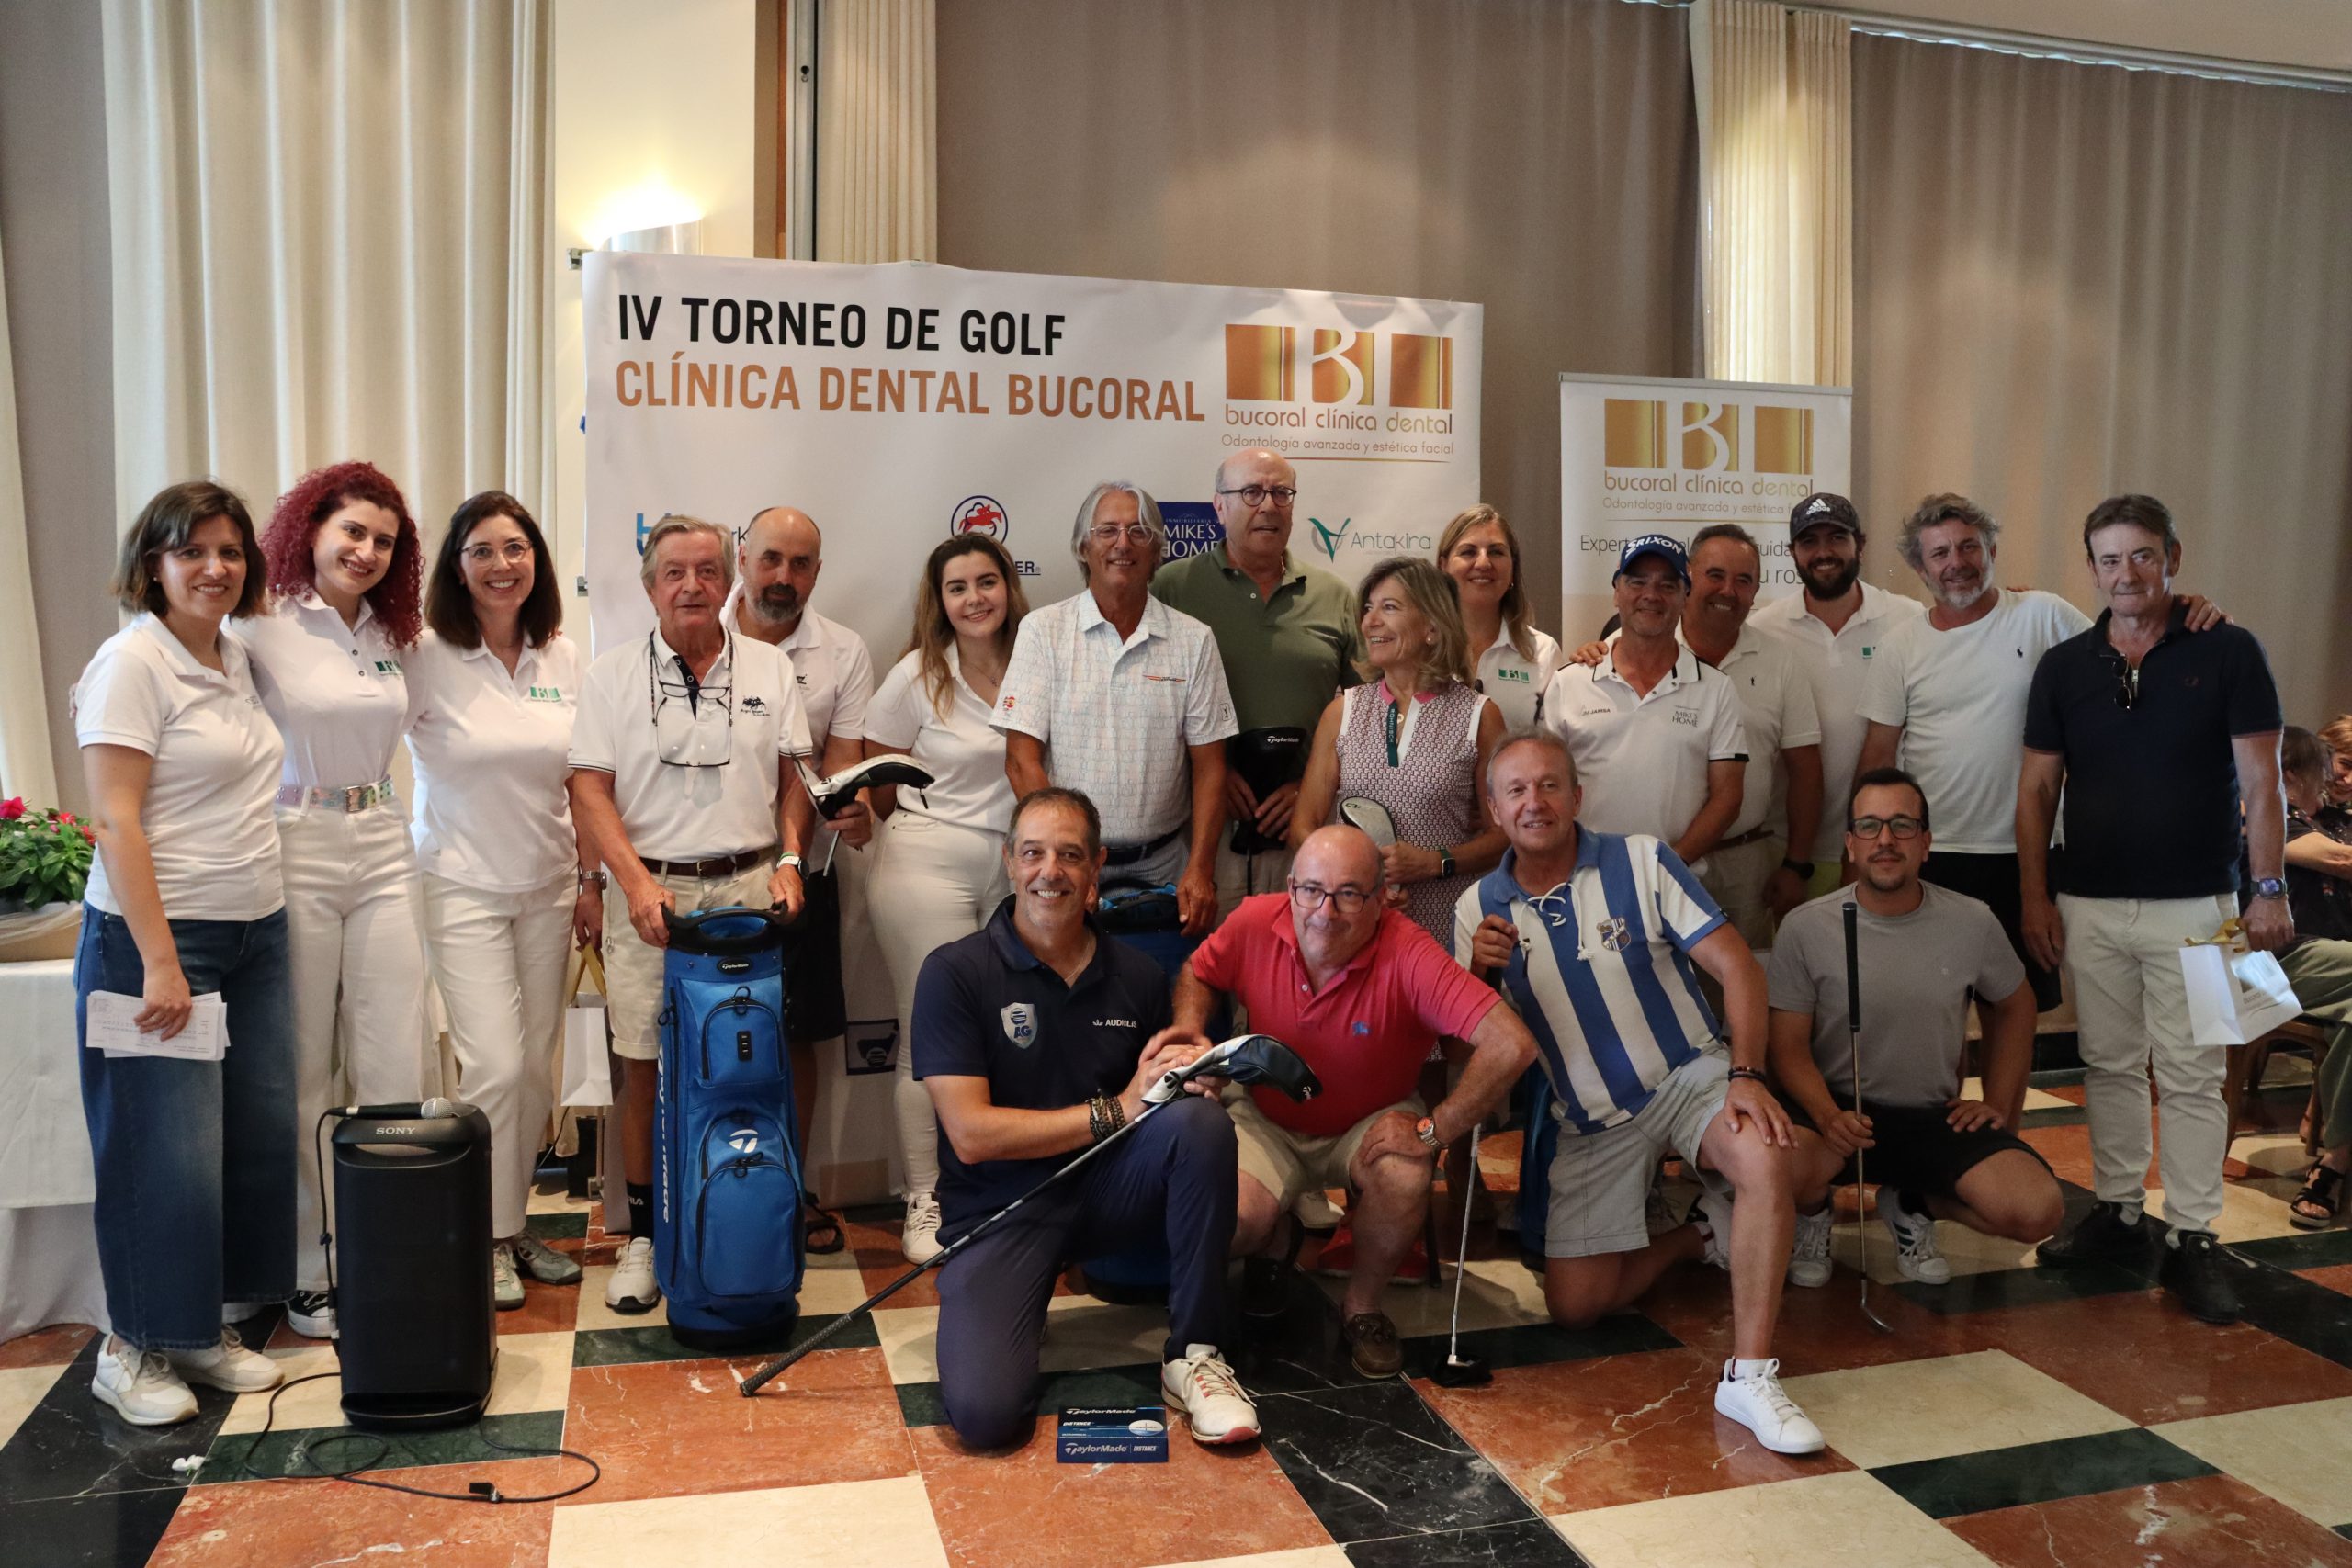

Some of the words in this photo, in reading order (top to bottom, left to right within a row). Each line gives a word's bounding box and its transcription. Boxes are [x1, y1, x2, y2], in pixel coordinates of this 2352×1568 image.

[618, 294, 663, 341] IV
[681, 297, 866, 349] TORNEO
[886, 306, 940, 352] DE
[960, 310, 1066, 355] GOLF
[616, 350, 801, 410] CLÍNICA
[819, 367, 989, 415] DENTAL
[1008, 373, 1205, 422] BUCORAL
[1225, 403, 1306, 428] bucoral
[1315, 407, 1377, 431] clínica
[1385, 413, 1453, 434] dental
[1221, 434, 1299, 451] Odontología
[1303, 438, 1360, 451] avanzada
[1363, 443, 1370, 454] y
[1373, 439, 1418, 453] estética
[1421, 441, 1453, 455] facial
[1604, 470, 1677, 492] bucoral
[1685, 474, 1744, 494] clínica
[1751, 477, 1814, 496] dental
[1602, 497, 1672, 513] Odontología
[1676, 499, 1730, 513] avanzada
[1732, 505, 1738, 515] y
[1741, 502, 1784, 514] estética
[1162, 522, 1216, 539] MIKE'S
[1351, 532, 1431, 556] Antakira
[1580, 535, 1633, 556] Expert
[1756, 540, 1792, 557] uida
[1625, 536, 1682, 559] SRIXON
[1013, 1025, 1032, 1039] AG
[375, 1127, 416, 1135] SONY
[1065, 1442, 1127, 1456] TaylorMade
